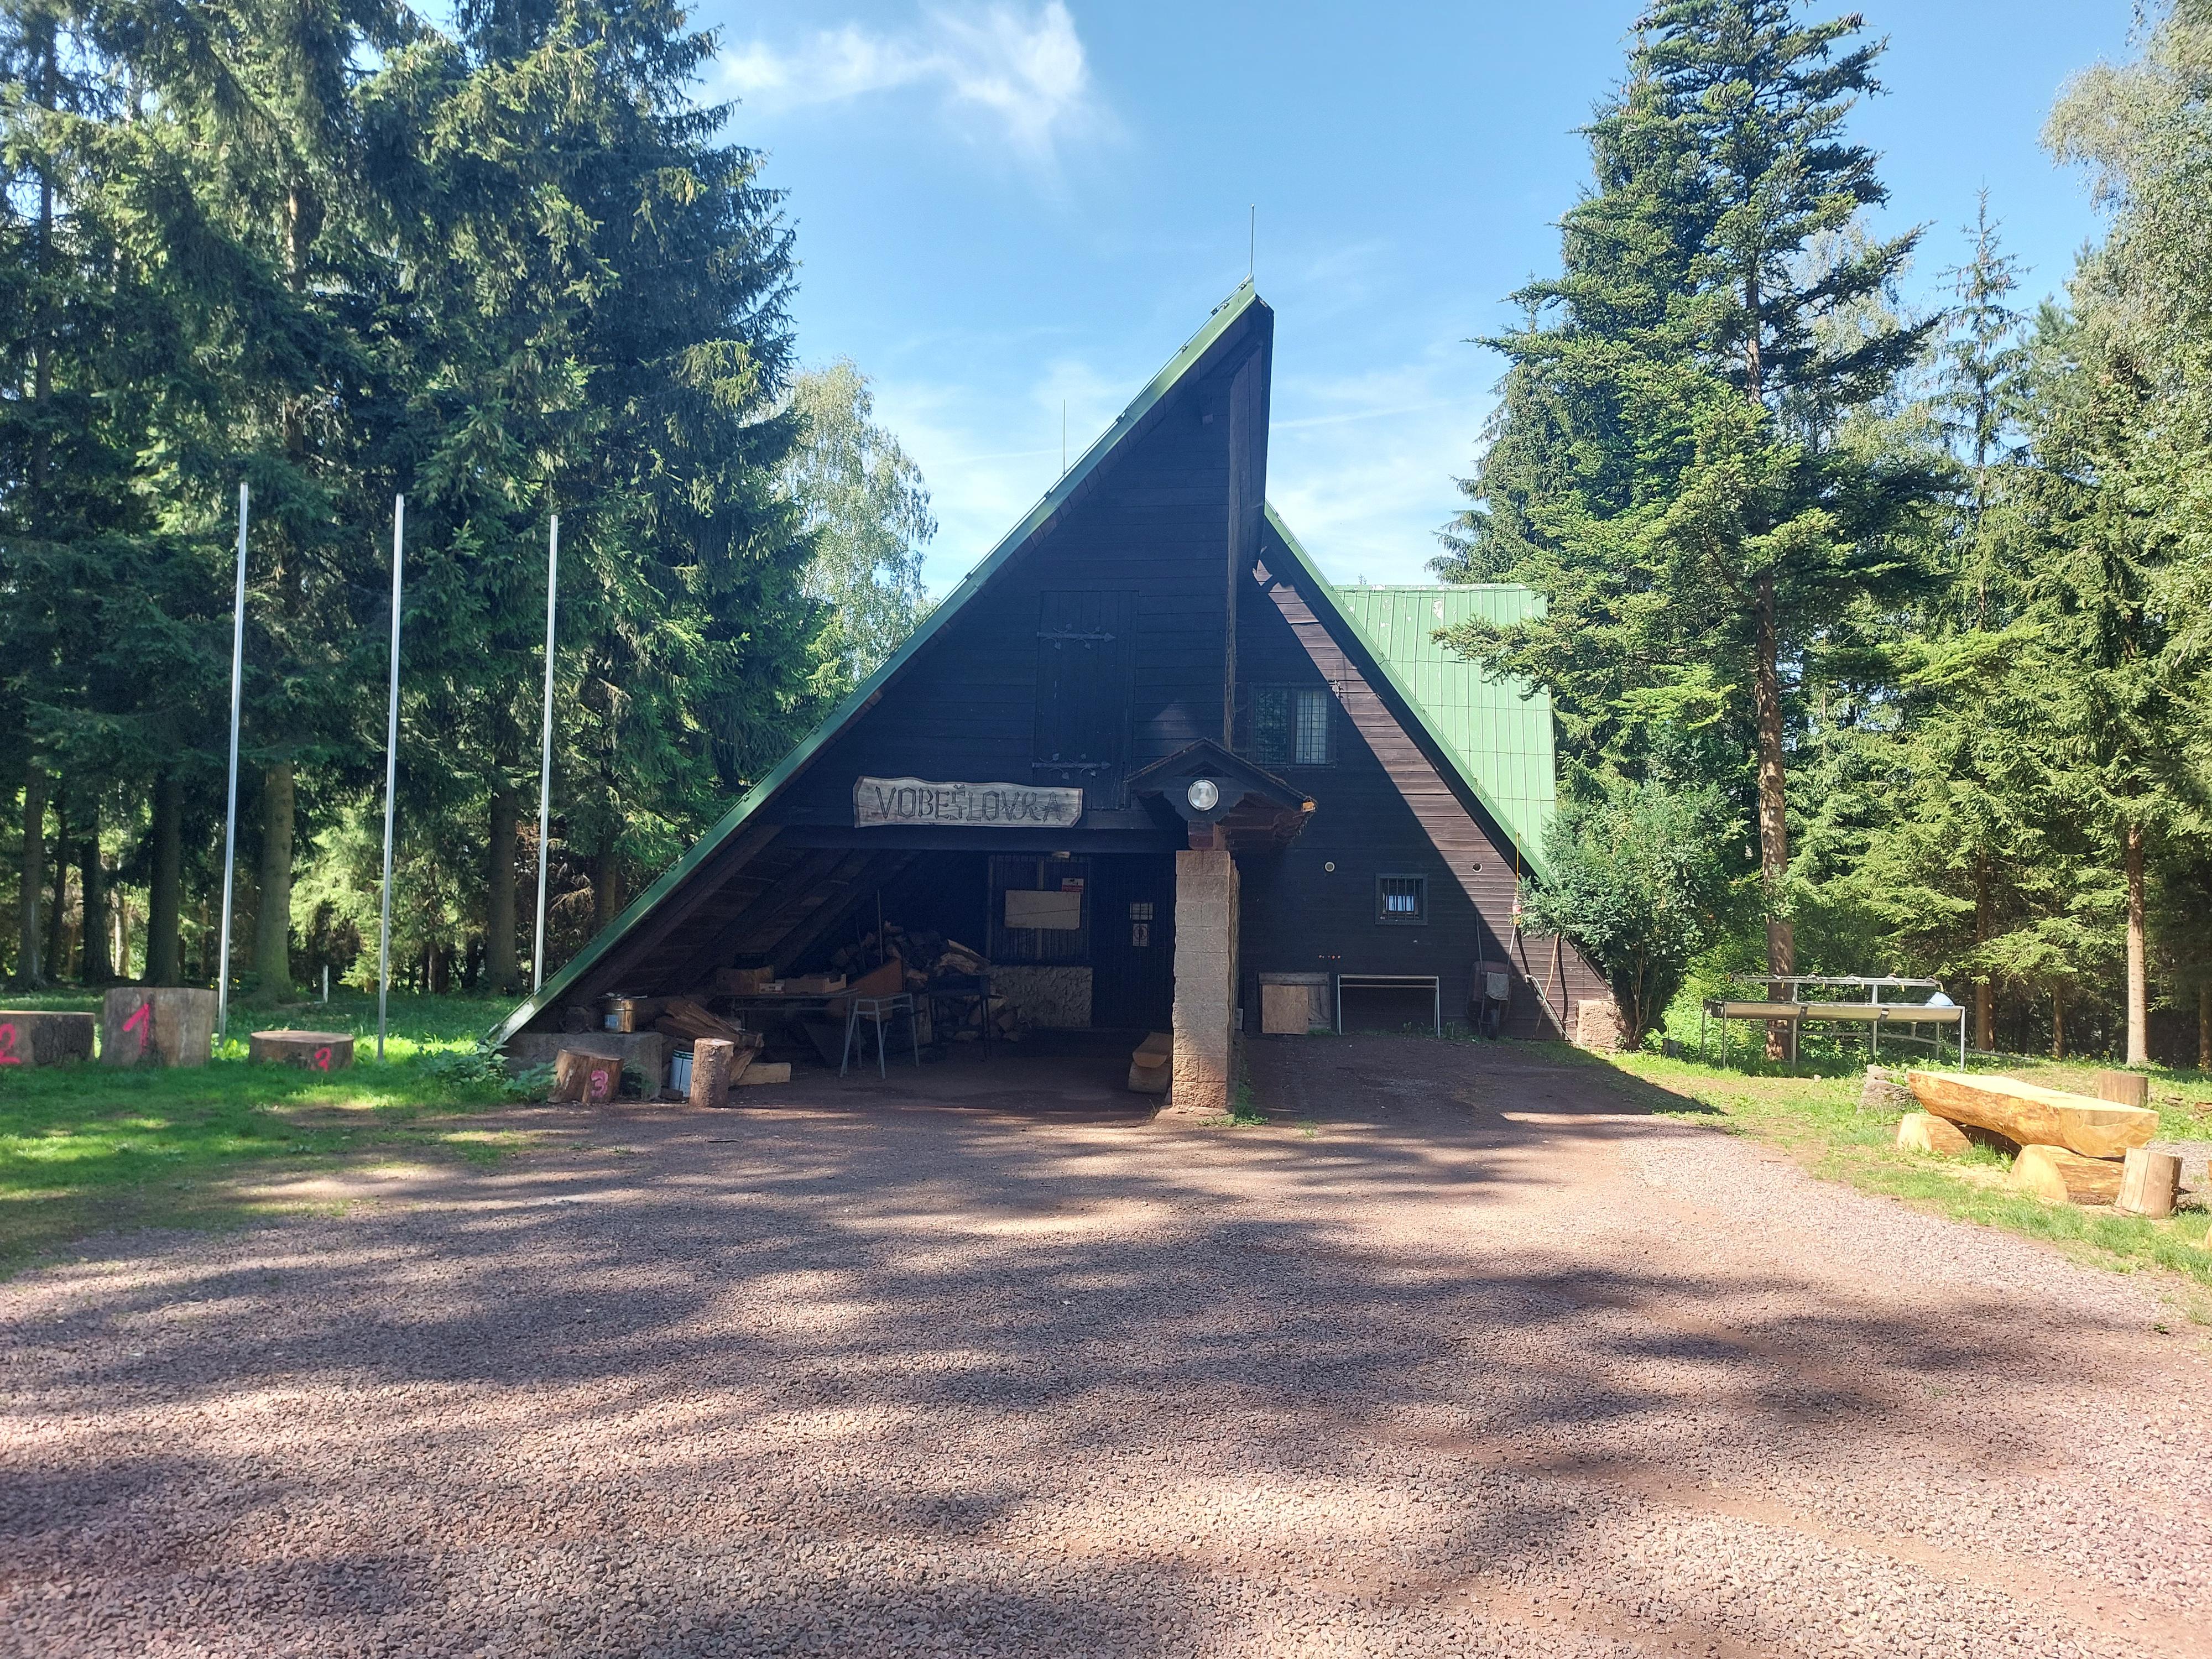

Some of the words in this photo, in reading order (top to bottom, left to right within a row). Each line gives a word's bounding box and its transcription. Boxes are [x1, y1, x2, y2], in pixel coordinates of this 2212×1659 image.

[875, 784, 1062, 822] VOBEŠLOVKA
[0, 1024, 21, 1065] 2
[122, 1003, 150, 1055] 1
[591, 1070, 608, 1097] 3
